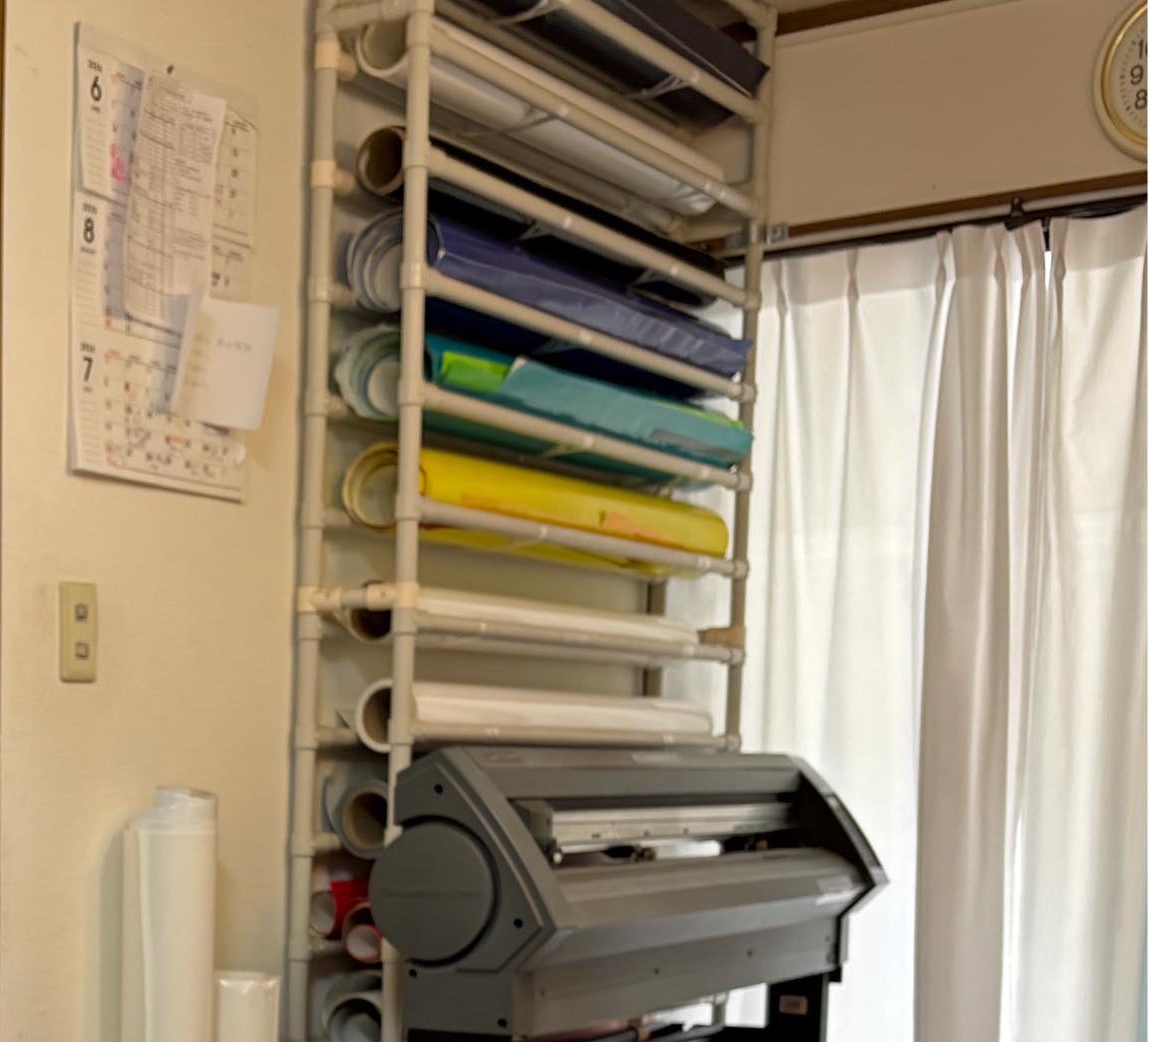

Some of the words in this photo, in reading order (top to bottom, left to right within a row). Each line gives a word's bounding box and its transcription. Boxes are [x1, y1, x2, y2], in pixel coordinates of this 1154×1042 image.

[90, 75, 103, 102] 6
[1130, 64, 1144, 86] 9
[1134, 88, 1148, 110] 8
[83, 217, 95, 244] 8
[82, 355, 94, 382] 7
